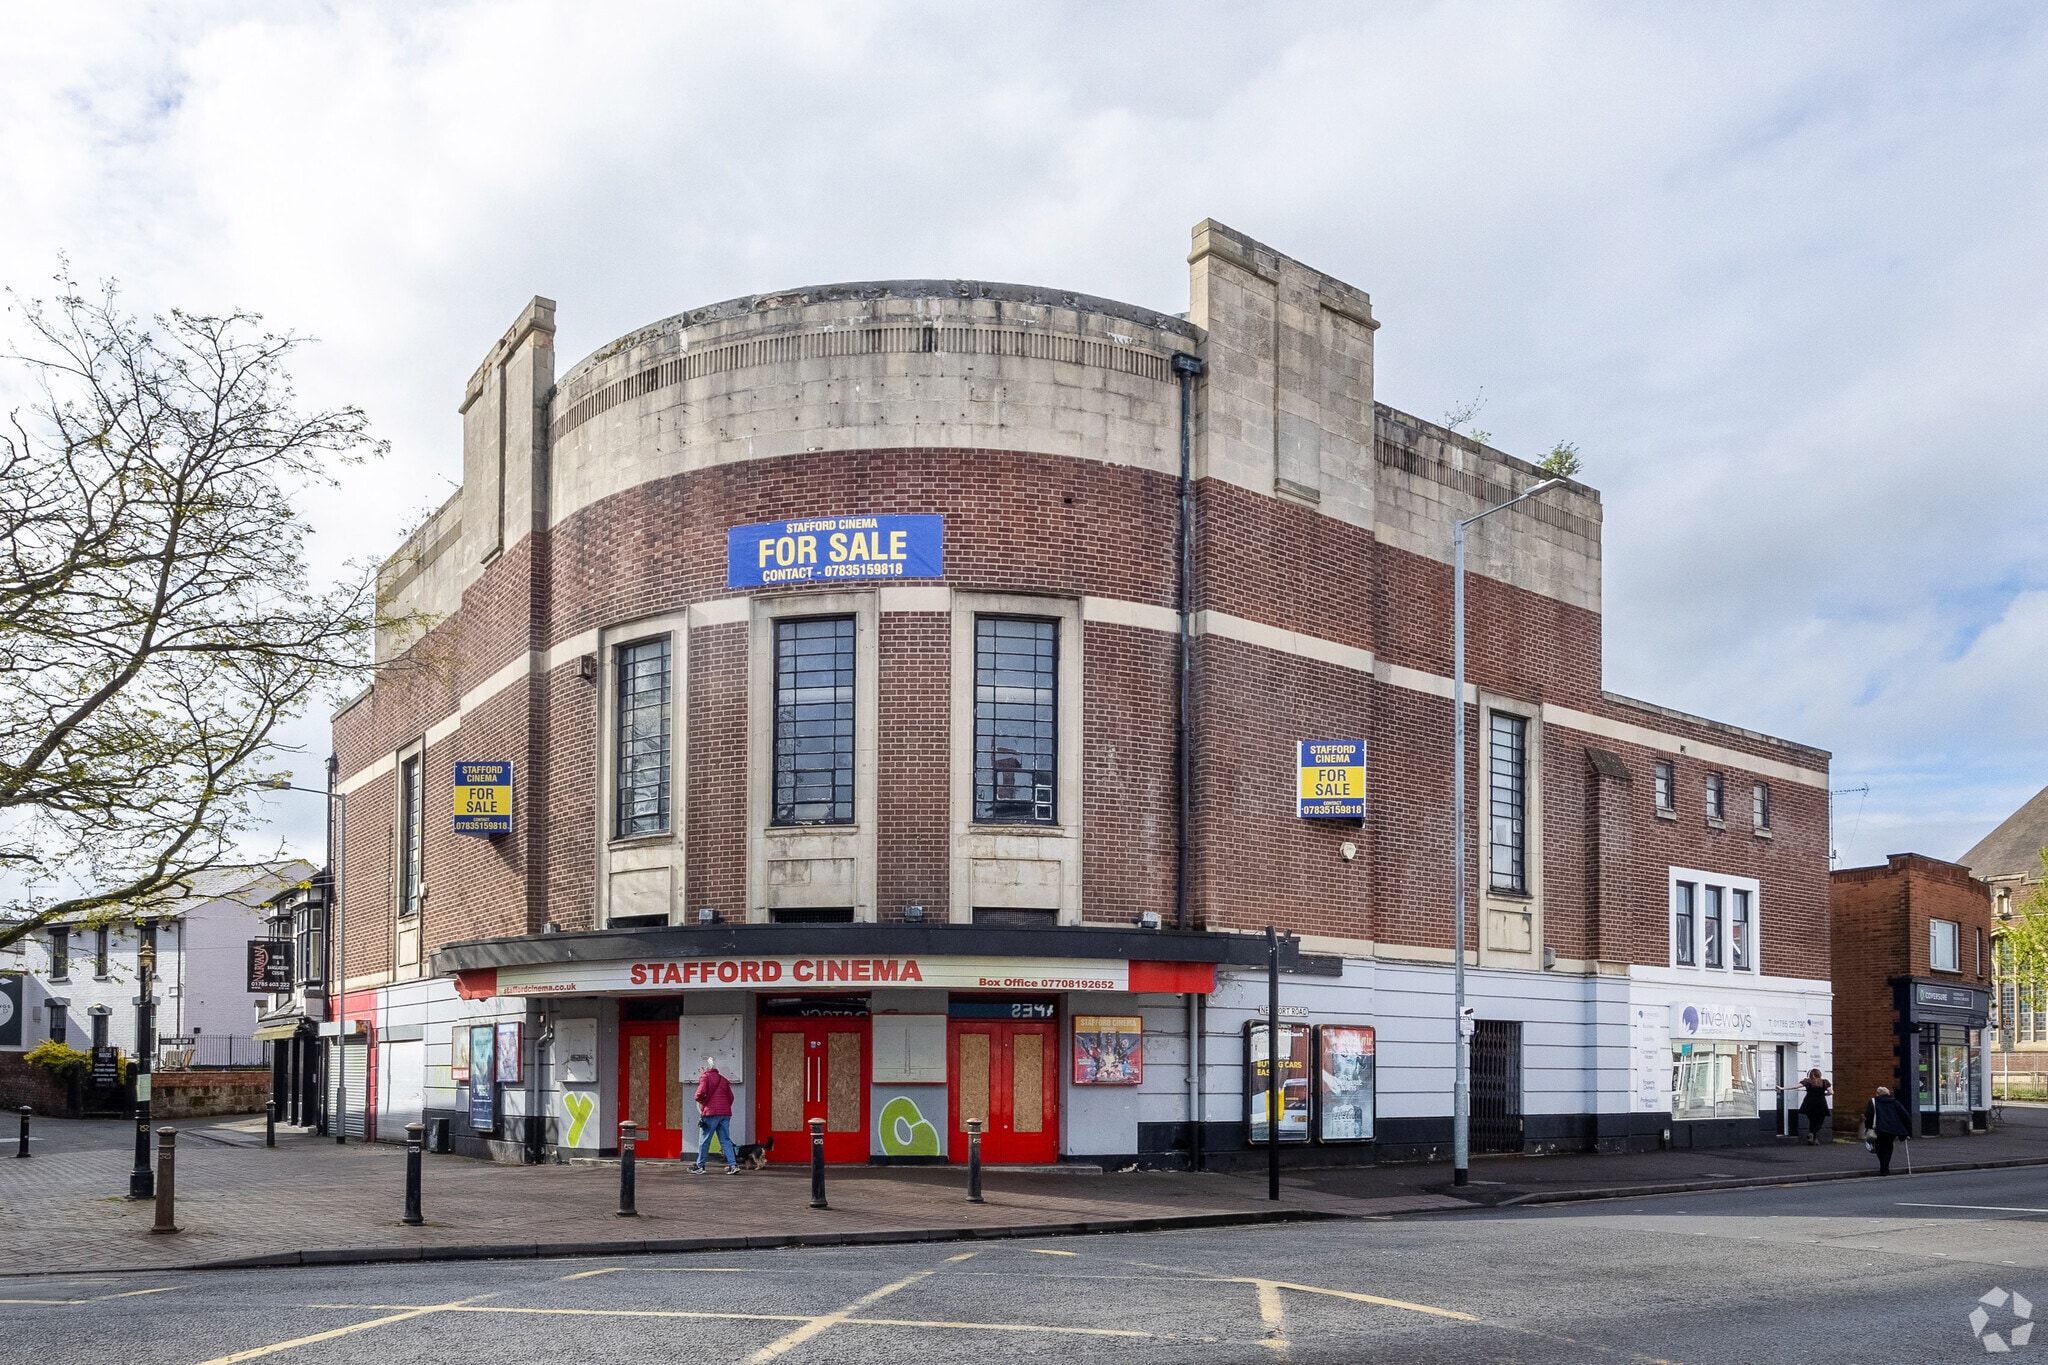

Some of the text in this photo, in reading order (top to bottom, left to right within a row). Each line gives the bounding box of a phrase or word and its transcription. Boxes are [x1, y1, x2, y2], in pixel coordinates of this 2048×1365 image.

[786, 518, 878, 534] STAFFORD CINEMA
[759, 531, 907, 568] FOR SALE
[762, 566, 813, 582] CONTACT
[824, 563, 903, 577] 07835159818
[1310, 745, 1356, 754] STAFFORD
[1315, 754, 1350, 763] CINEMA
[462, 765, 503, 774] STAFFORD
[1319, 769, 1346, 781] FOR
[466, 774, 497, 782] CINEMA
[469, 788, 494, 799] FOR
[1315, 783, 1350, 795] SALE
[466, 801, 497, 812] SALE
[1303, 805, 1361, 814] 07835159818
[456, 822, 507, 830] 07835159818
[630, 959, 923, 985] STAFFORD CINEMA
[503, 983, 577, 994] staffordcinema.co.uk
[979, 978, 1114, 989] Box Office 07708192652
[1260, 1006, 1308, 1016] NEORT ROAD
[1700, 1008, 1751, 1032] fiveways
